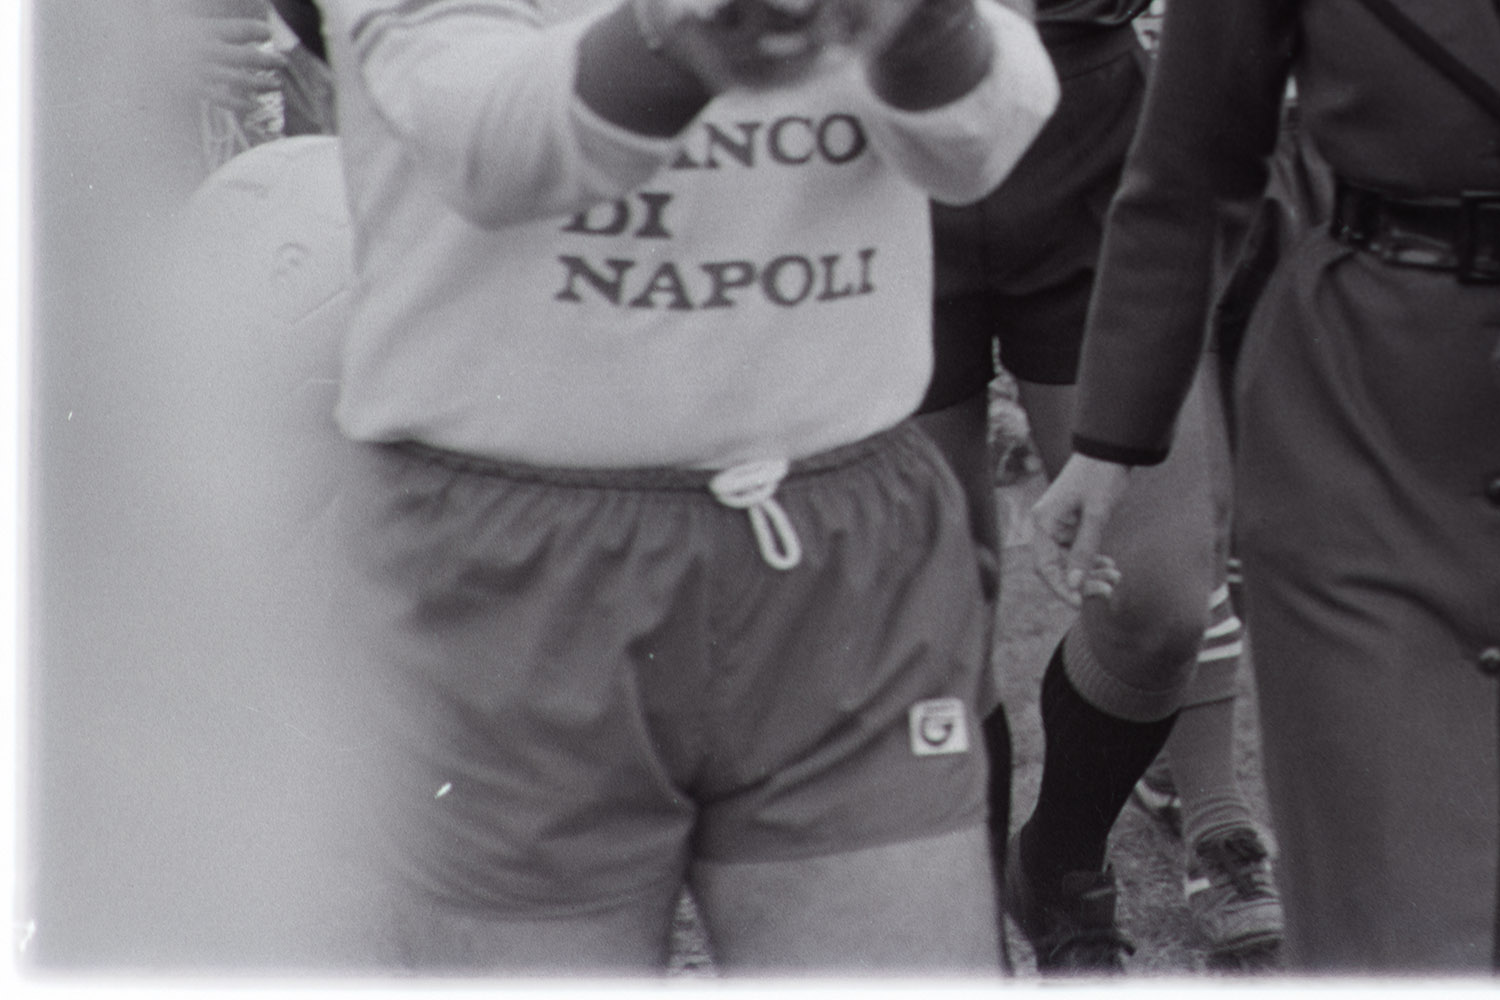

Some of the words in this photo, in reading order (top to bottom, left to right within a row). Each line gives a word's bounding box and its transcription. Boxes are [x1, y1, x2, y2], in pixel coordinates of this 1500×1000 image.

[670, 112, 868, 170] NCO
[561, 192, 673, 239] DI
[554, 248, 876, 311] NAPOLI
